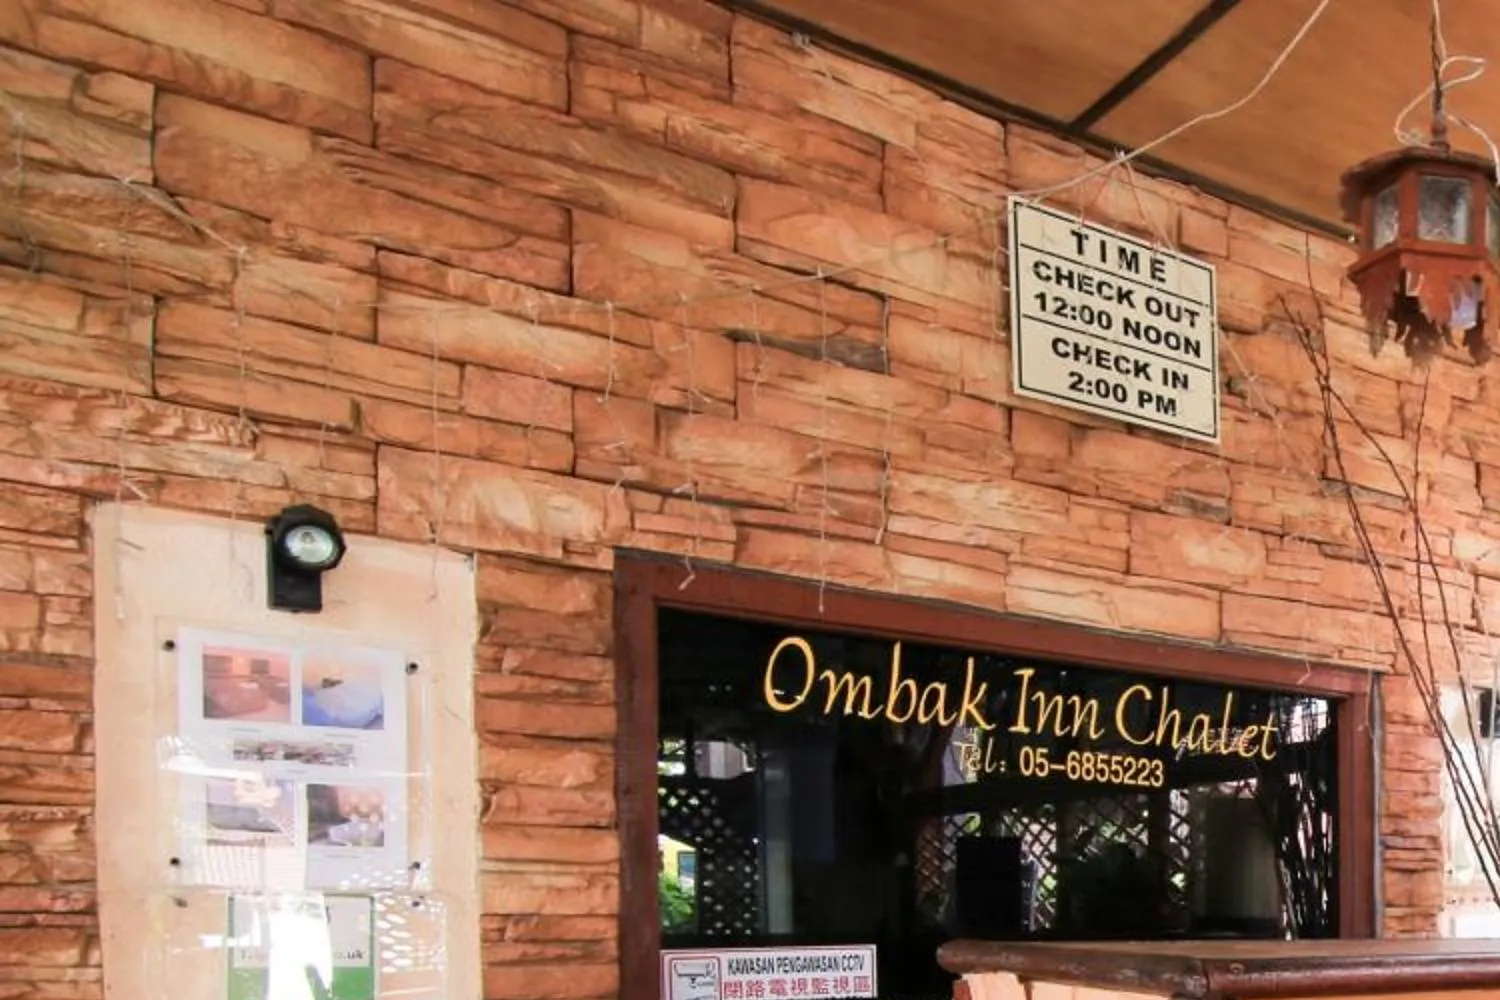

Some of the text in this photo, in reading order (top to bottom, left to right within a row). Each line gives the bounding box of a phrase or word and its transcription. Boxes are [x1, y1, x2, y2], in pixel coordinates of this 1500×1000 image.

[1070, 230, 1167, 283] TIME
[1032, 260, 1200, 329] CHECK OUT
[1034, 291, 1201, 358] 12:00 NOON
[1051, 337, 1189, 391] CHECK IN
[1068, 371, 1177, 417] 2:00 PM
[763, 635, 1279, 762] Ombak Inn Chalet
[952, 737, 1165, 788] Tel: 05-6855223
[728, 954, 866, 976] KAWASAN PENGAWASAN CCTV
